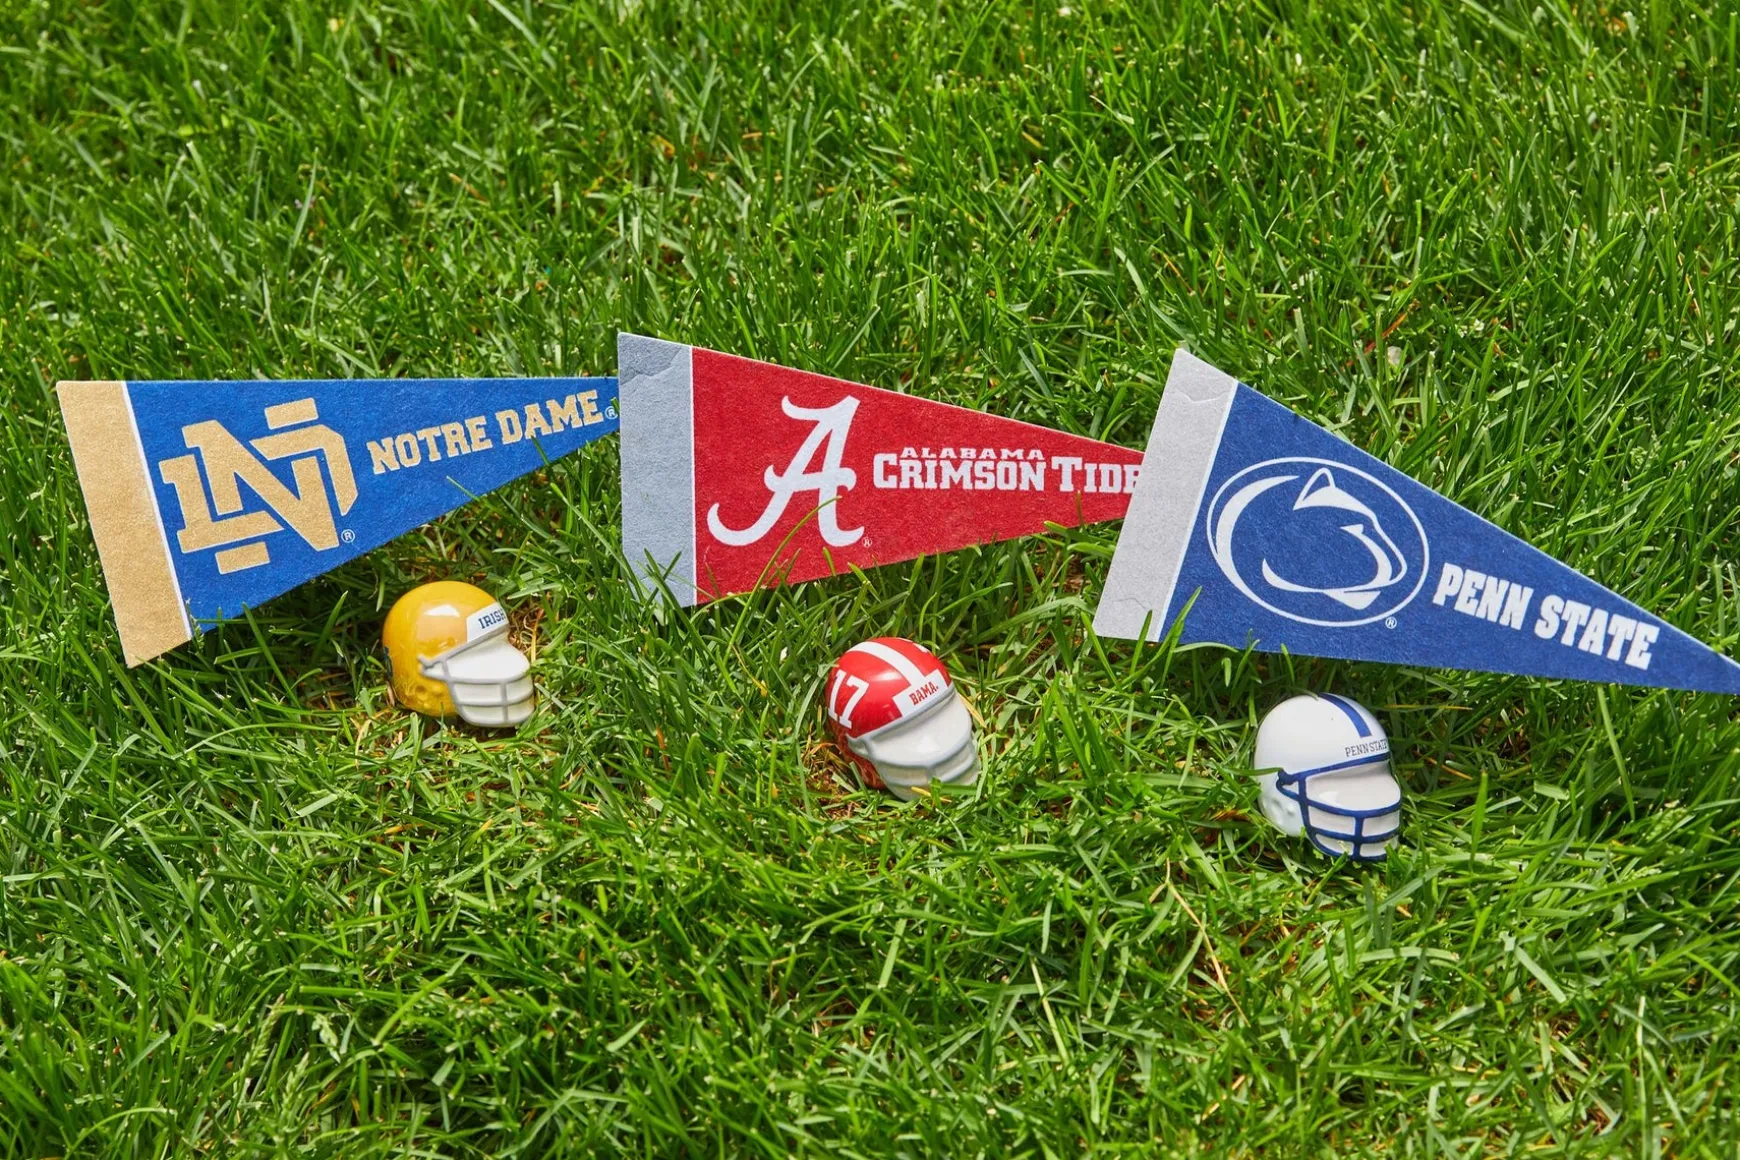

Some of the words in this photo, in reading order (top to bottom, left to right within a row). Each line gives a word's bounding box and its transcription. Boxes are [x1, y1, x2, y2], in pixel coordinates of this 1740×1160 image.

[366, 415, 493, 475] NOTRE
[495, 389, 604, 446] DAME
[900, 446, 1046, 461] ALABAMA
[706, 395, 865, 547] A
[873, 452, 1047, 491] CRIMSON
[478, 608, 507, 629] IRISH
[1432, 562, 1534, 631] PENN
[1534, 594, 1660, 670] STATE
[828, 669, 870, 729] 17
[1345, 743, 1369, 757] PENN
